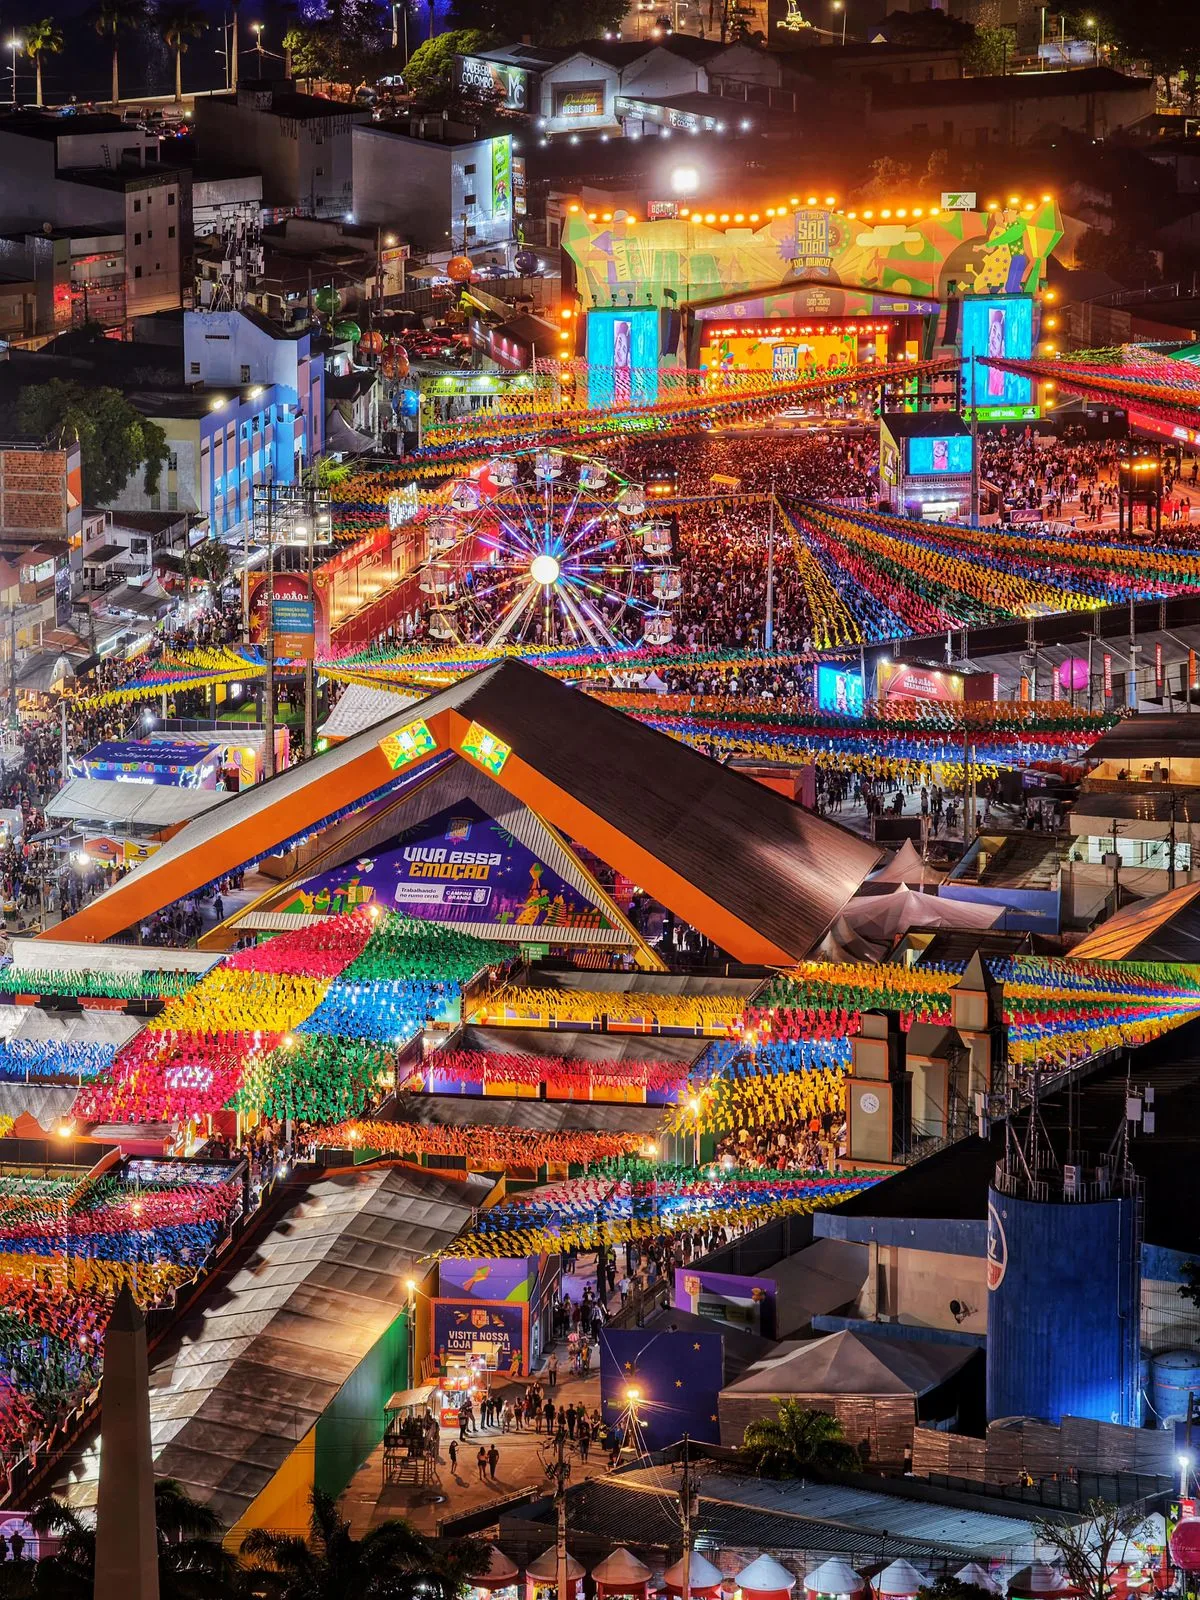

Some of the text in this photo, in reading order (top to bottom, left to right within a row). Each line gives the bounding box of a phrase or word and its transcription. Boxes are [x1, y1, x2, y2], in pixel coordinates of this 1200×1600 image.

[462, 72, 494, 88] COLOMBO
[798, 219, 827, 239] SÃO
[799, 239, 826, 254] JOÃO
[806, 258, 831, 268] MUNDO
[282, 591, 303, 600] JOÃO
[403, 847, 447, 863] VIVA
[449, 1331, 509, 1341] VISITE NOSSA
[448, 1340, 471, 1349] LOJA
